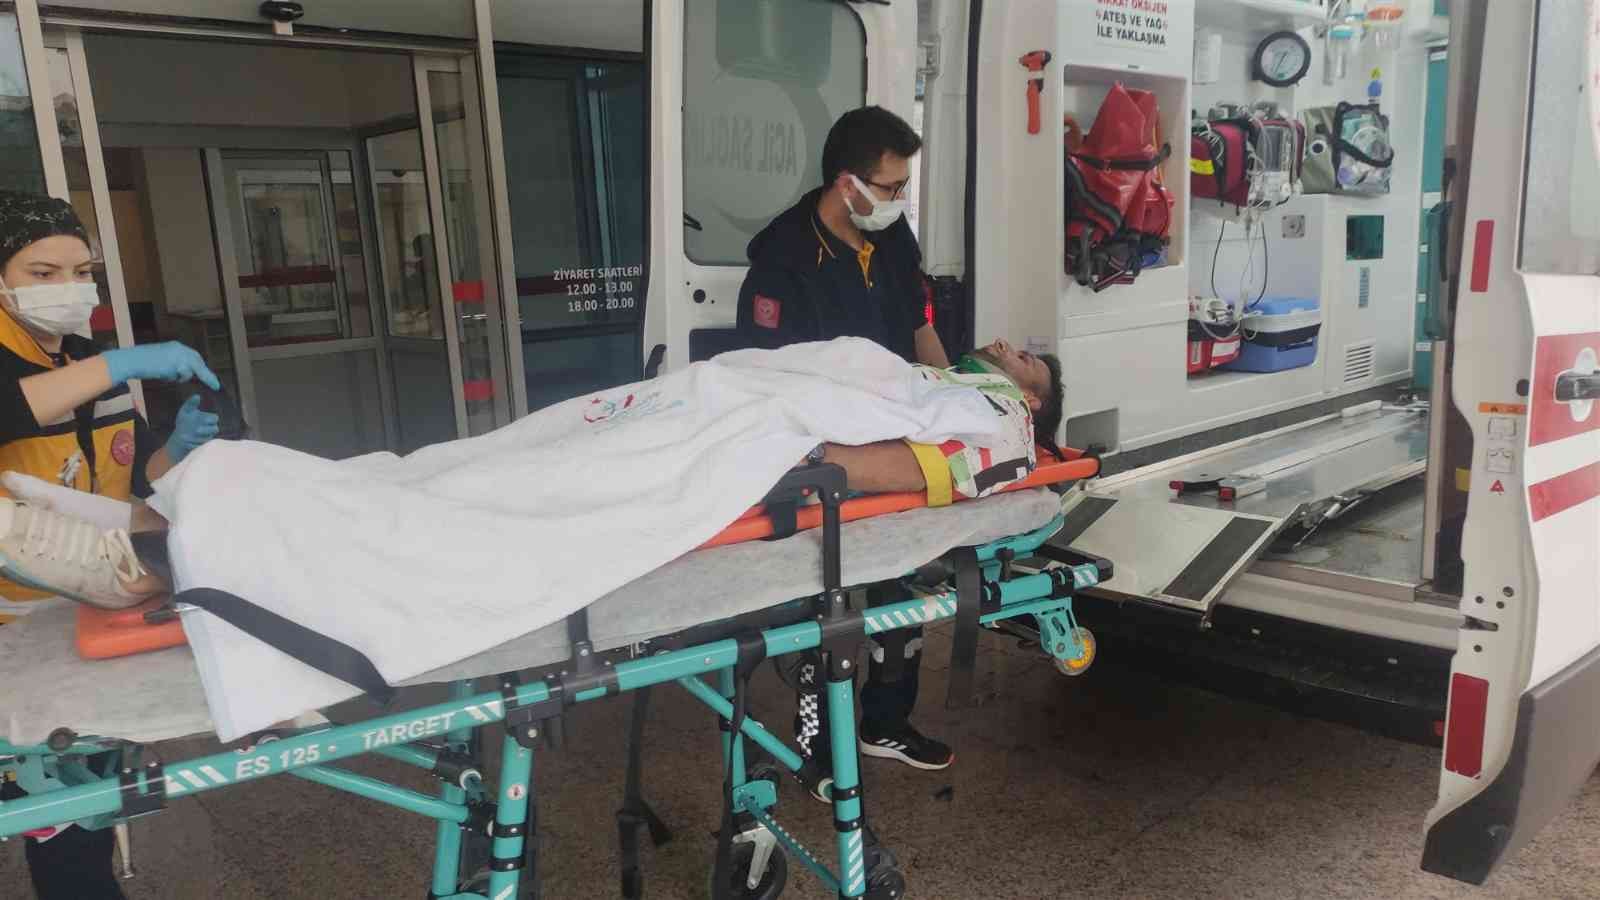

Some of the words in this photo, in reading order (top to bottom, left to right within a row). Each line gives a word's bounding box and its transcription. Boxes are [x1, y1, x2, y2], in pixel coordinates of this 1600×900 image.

[1103, 10, 1127, 25] ATEŞ
[1130, 15, 1141, 26] VE
[1116, 28, 1166, 45] YAKLAŞMA
[553, 267, 595, 280] ZİYARET
[598, 264, 642, 279] SAATLERİ
[567, 283, 596, 296] 12.00
[605, 281, 633, 294] 13.00
[568, 299, 598, 312] 18.00
[606, 297, 634, 310] 20.00
[235, 756, 271, 780] ES
[279, 744, 320, 769] 125
[362, 711, 456, 749] TARGET
